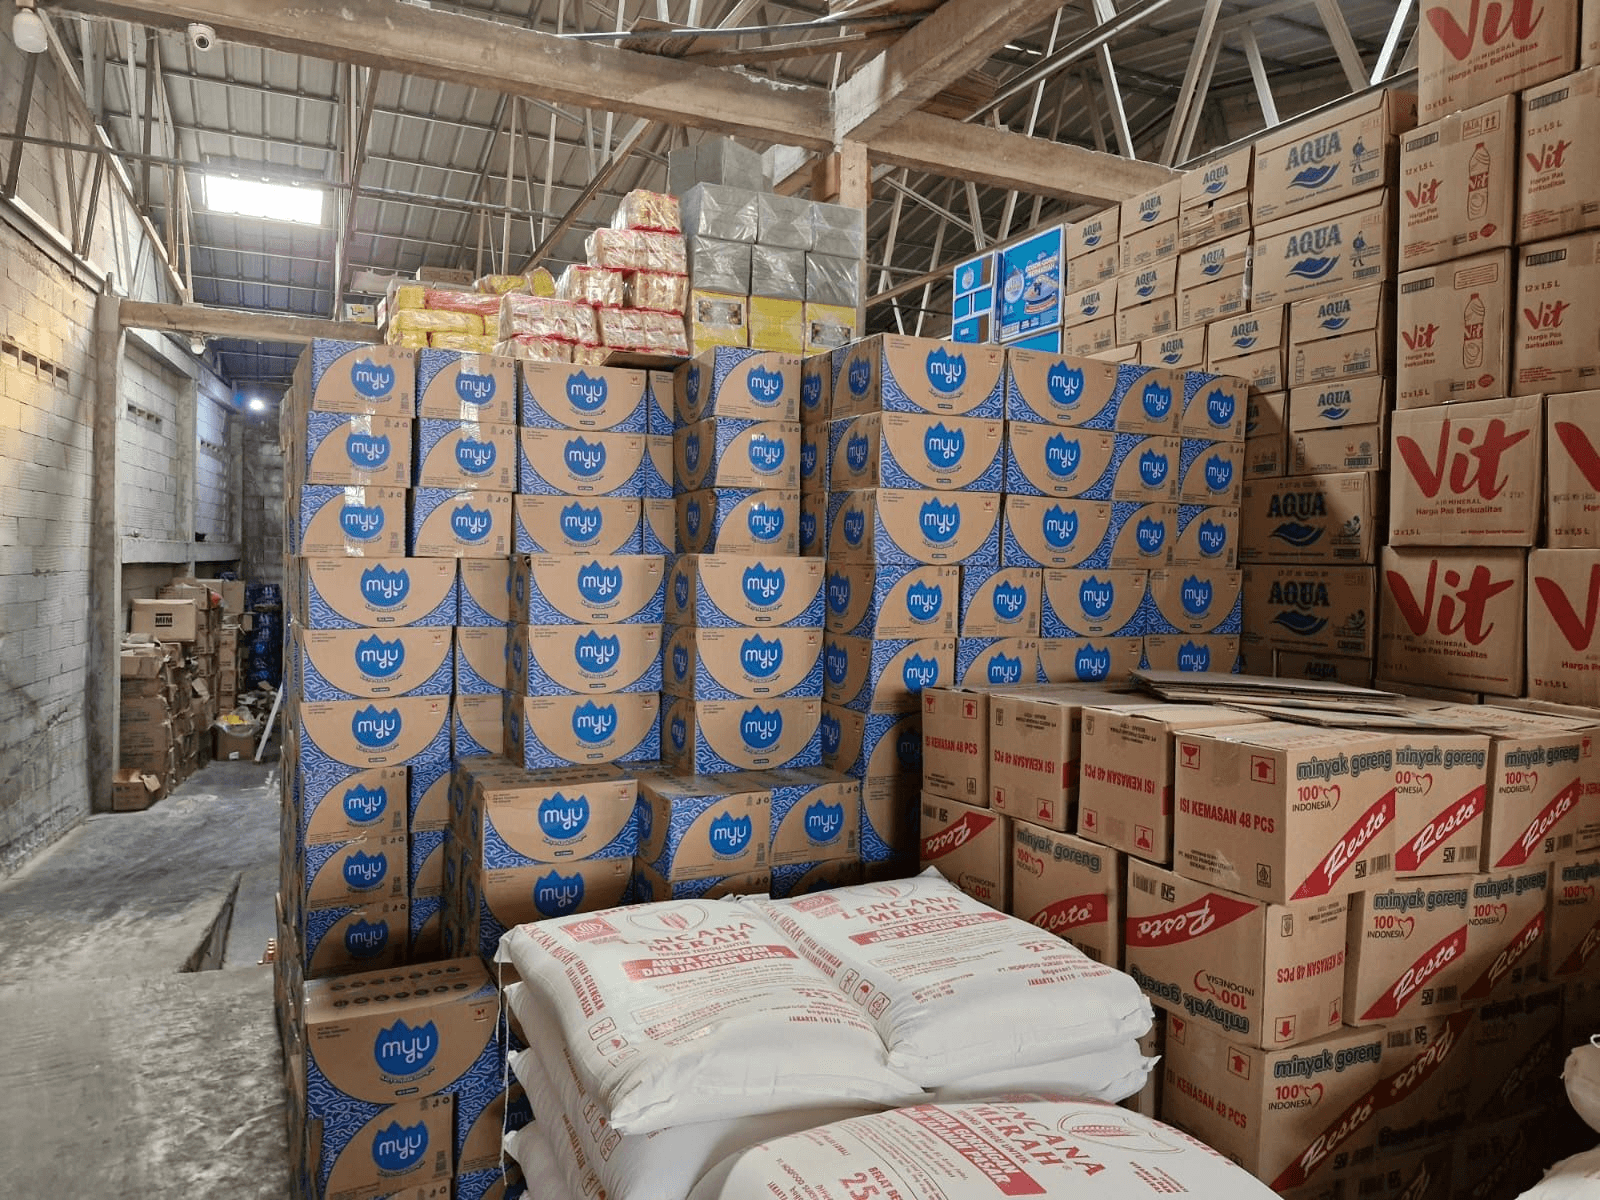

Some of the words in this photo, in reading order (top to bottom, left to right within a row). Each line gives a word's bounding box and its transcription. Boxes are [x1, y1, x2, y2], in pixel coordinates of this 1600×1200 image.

[1285, 131, 1341, 171] AQUA
[1526, 140, 1572, 172] Vit
[1203, 166, 1229, 184] AQUA
[1405, 179, 1443, 208] Vit
[1139, 196, 1162, 213] AQUA
[1082, 222, 1102, 238] AQUA
[1284, 224, 1342, 259] AQUA
[1201, 248, 1225, 264] AQUA
[1135, 271, 1157, 287] AQUA
[1080, 292, 1100, 306] AQUA
[1317, 300, 1351, 318] AQUA
[1523, 300, 1570, 330] Vit
[1231, 320, 1259, 336] AQUA
[1402, 324, 1439, 350] Vit
[1160, 338, 1184, 354] AQUA
[356, 371, 390, 390] myu
[931, 362, 962, 383] myu
[460, 378, 491, 398] myu
[570, 382, 603, 401] myu
[752, 377, 778, 395] myu
[1052, 376, 1079, 395] myu
[1146, 393, 1168, 410] myu
[1317, 390, 1351, 406] AQUA
[1210, 401, 1231, 417] myu
[352, 441, 385, 460] myu
[929, 437, 960, 458] myu
[1396, 418, 1530, 500] Vit
[1266, 492, 1328, 521] AQUA
[345, 512, 379, 530] myu
[455, 514, 487, 532] myu
[564, 514, 597, 533] myu
[752, 514, 780, 531] myu
[924, 512, 955, 531] myu
[1047, 519, 1073, 538] myu
[1139, 529, 1162, 544] myu
[1202, 530, 1223, 546] myu
[366, 579, 403, 599] myu
[582, 575, 617, 594] myu
[747, 577, 779, 597] myu
[911, 594, 939, 612] myu
[996, 594, 1022, 612] myu
[1083, 590, 1110, 608] myu
[1184, 587, 1209, 606] myu
[1268, 581, 1330, 610] AQUA
[1387, 559, 1514, 645] Vit
[361, 648, 398, 668] myu
[1079, 657, 1105, 676] myu
[906, 666, 935, 685] myu
[991, 665, 1018, 683] myu
[1304, 662, 1337, 678] AQUA
[358, 719, 396, 739] myu
[576, 714, 612, 733] myu
[745, 720, 777, 739] myu
[1296, 753, 1349, 781] minyak
[1350, 749, 1393, 778] goreng
[1444, 749, 1485, 769] goreng
[348, 795, 382, 813] myu
[544, 808, 583, 830] myu
[809, 813, 838, 833] myu
[1180, 797, 1190, 813] ISI
[1191, 800, 1237, 825] KEMASAN
[1238, 811, 1252, 829] 48
[1254, 815, 1275, 834] PCS
[1413, 803, 1475, 863] Resto
[1522, 794, 1572, 857] Resto
[714, 826, 747, 845] myu
[1323, 811, 1386, 886] Resto
[348, 862, 382, 880] myu
[540, 884, 578, 906] myu
[1373, 889, 1425, 913] minyak
[1426, 889, 1468, 911] goreng
[867, 904, 960, 924] MERAH
[1469, 917, 1499, 926] NDONESIA
[350, 928, 383, 946] myu
[648, 931, 751, 952] MERAH
[1393, 946, 1456, 1010] Resto
[382, 1035, 430, 1063] myu
[1274, 1050, 1333, 1079] minyak
[1335, 1041, 1382, 1072] goreng
[969, 1106, 1065, 1166] MERAH
[998, 1102, 1107, 1176] ENCANA
[379, 1134, 421, 1159] myu
